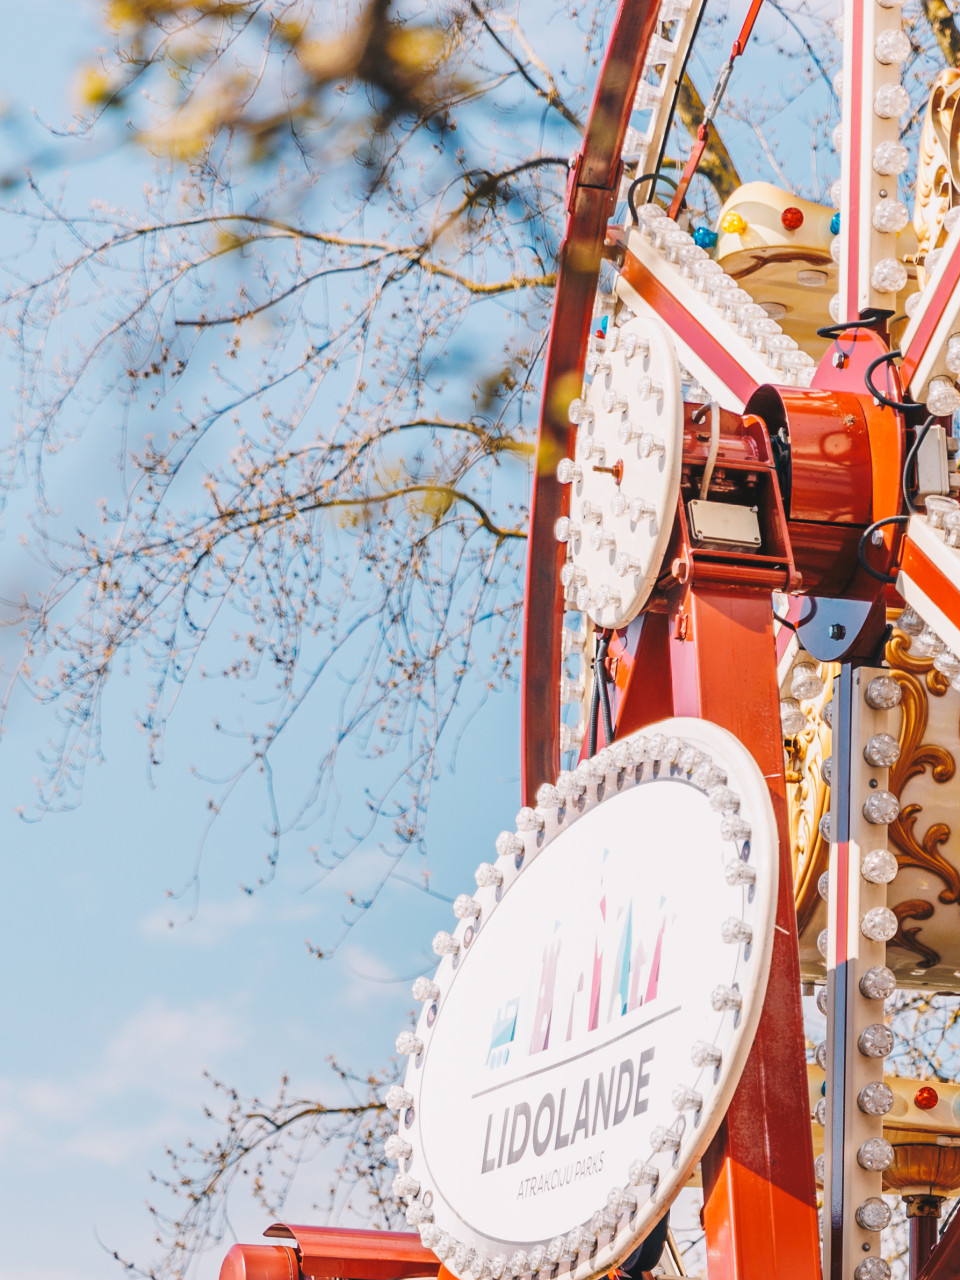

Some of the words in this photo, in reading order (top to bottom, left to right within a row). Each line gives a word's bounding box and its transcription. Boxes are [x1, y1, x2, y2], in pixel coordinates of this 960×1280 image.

[480, 1046, 656, 1175] LIDOLANDE
[516, 1162, 574, 1201] ATRAKCIJU
[574, 1150, 605, 1182] PARKS
